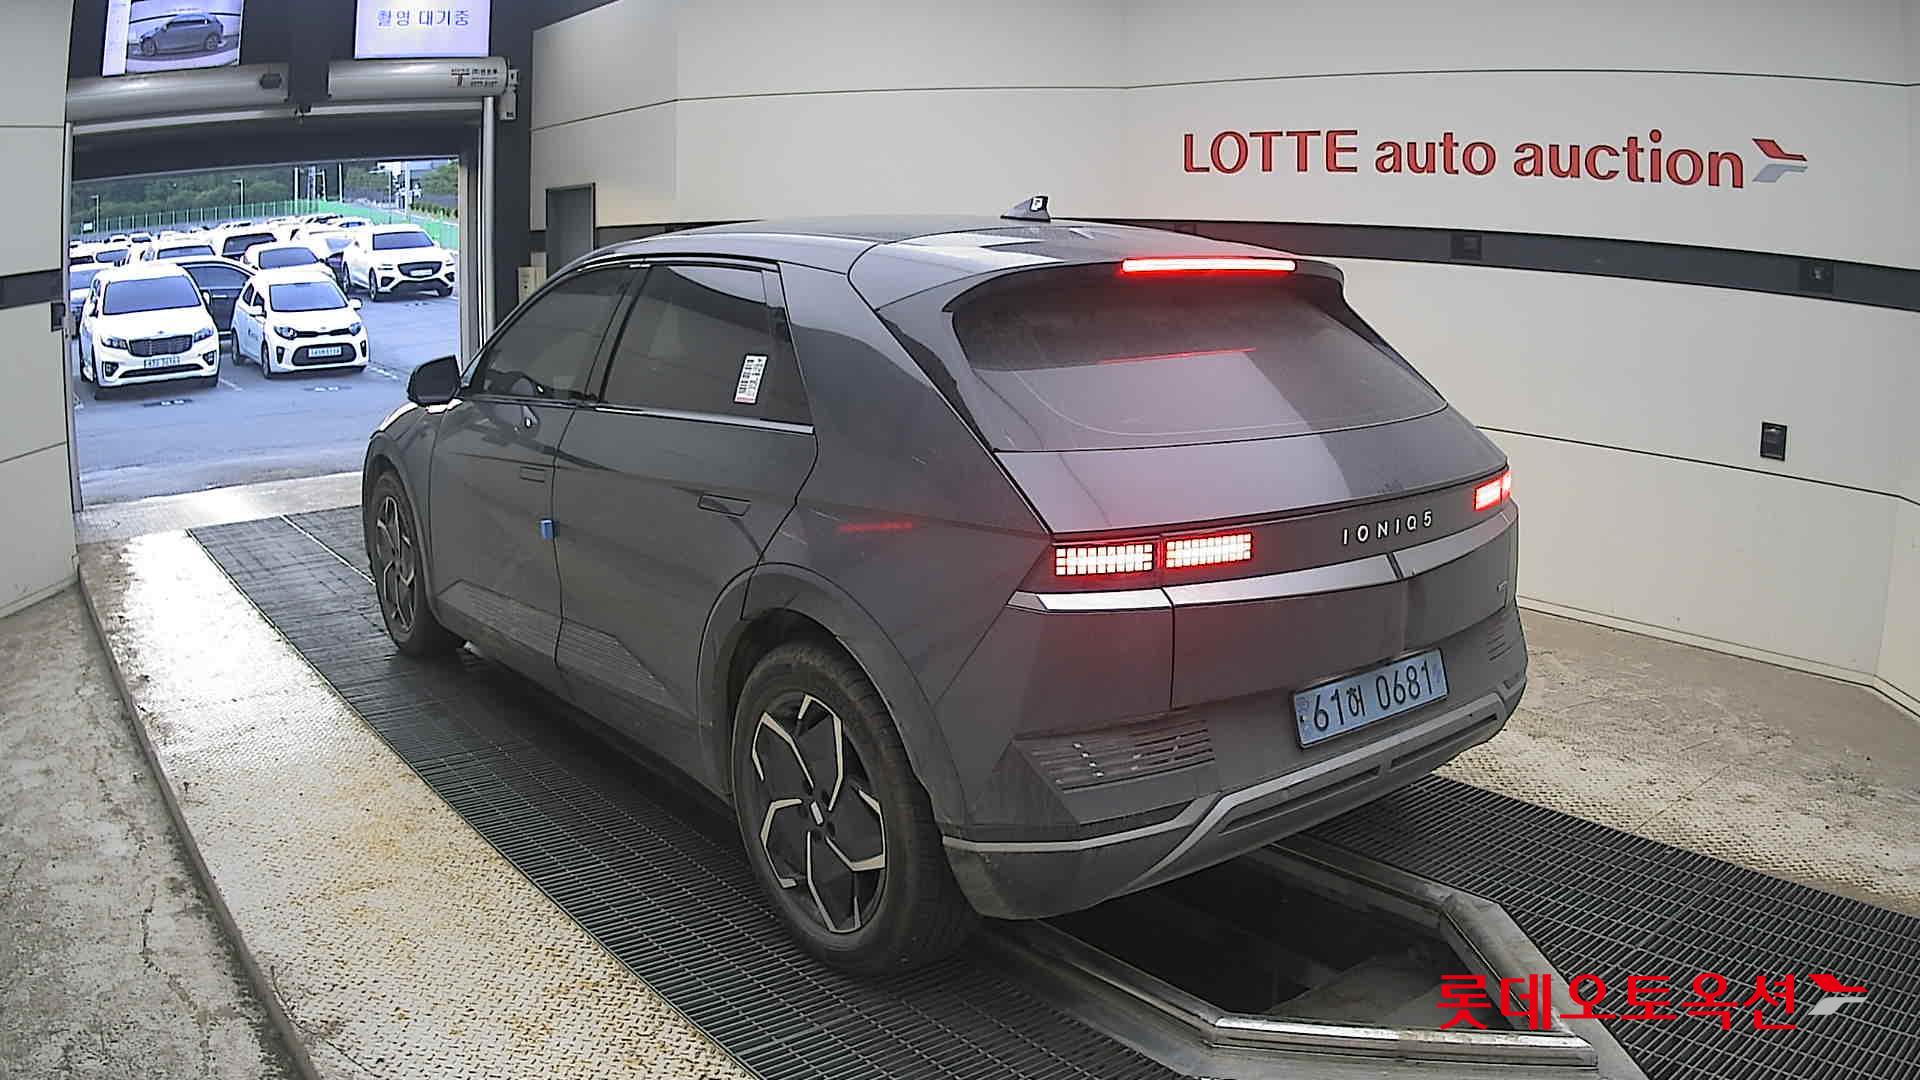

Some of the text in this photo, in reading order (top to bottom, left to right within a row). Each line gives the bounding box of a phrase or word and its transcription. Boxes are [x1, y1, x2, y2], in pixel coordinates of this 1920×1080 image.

[419, 9, 469, 26] 대기중
[1183, 129, 1745, 189] LOTTE auto auction
[1376, 660, 1433, 708] 0681
